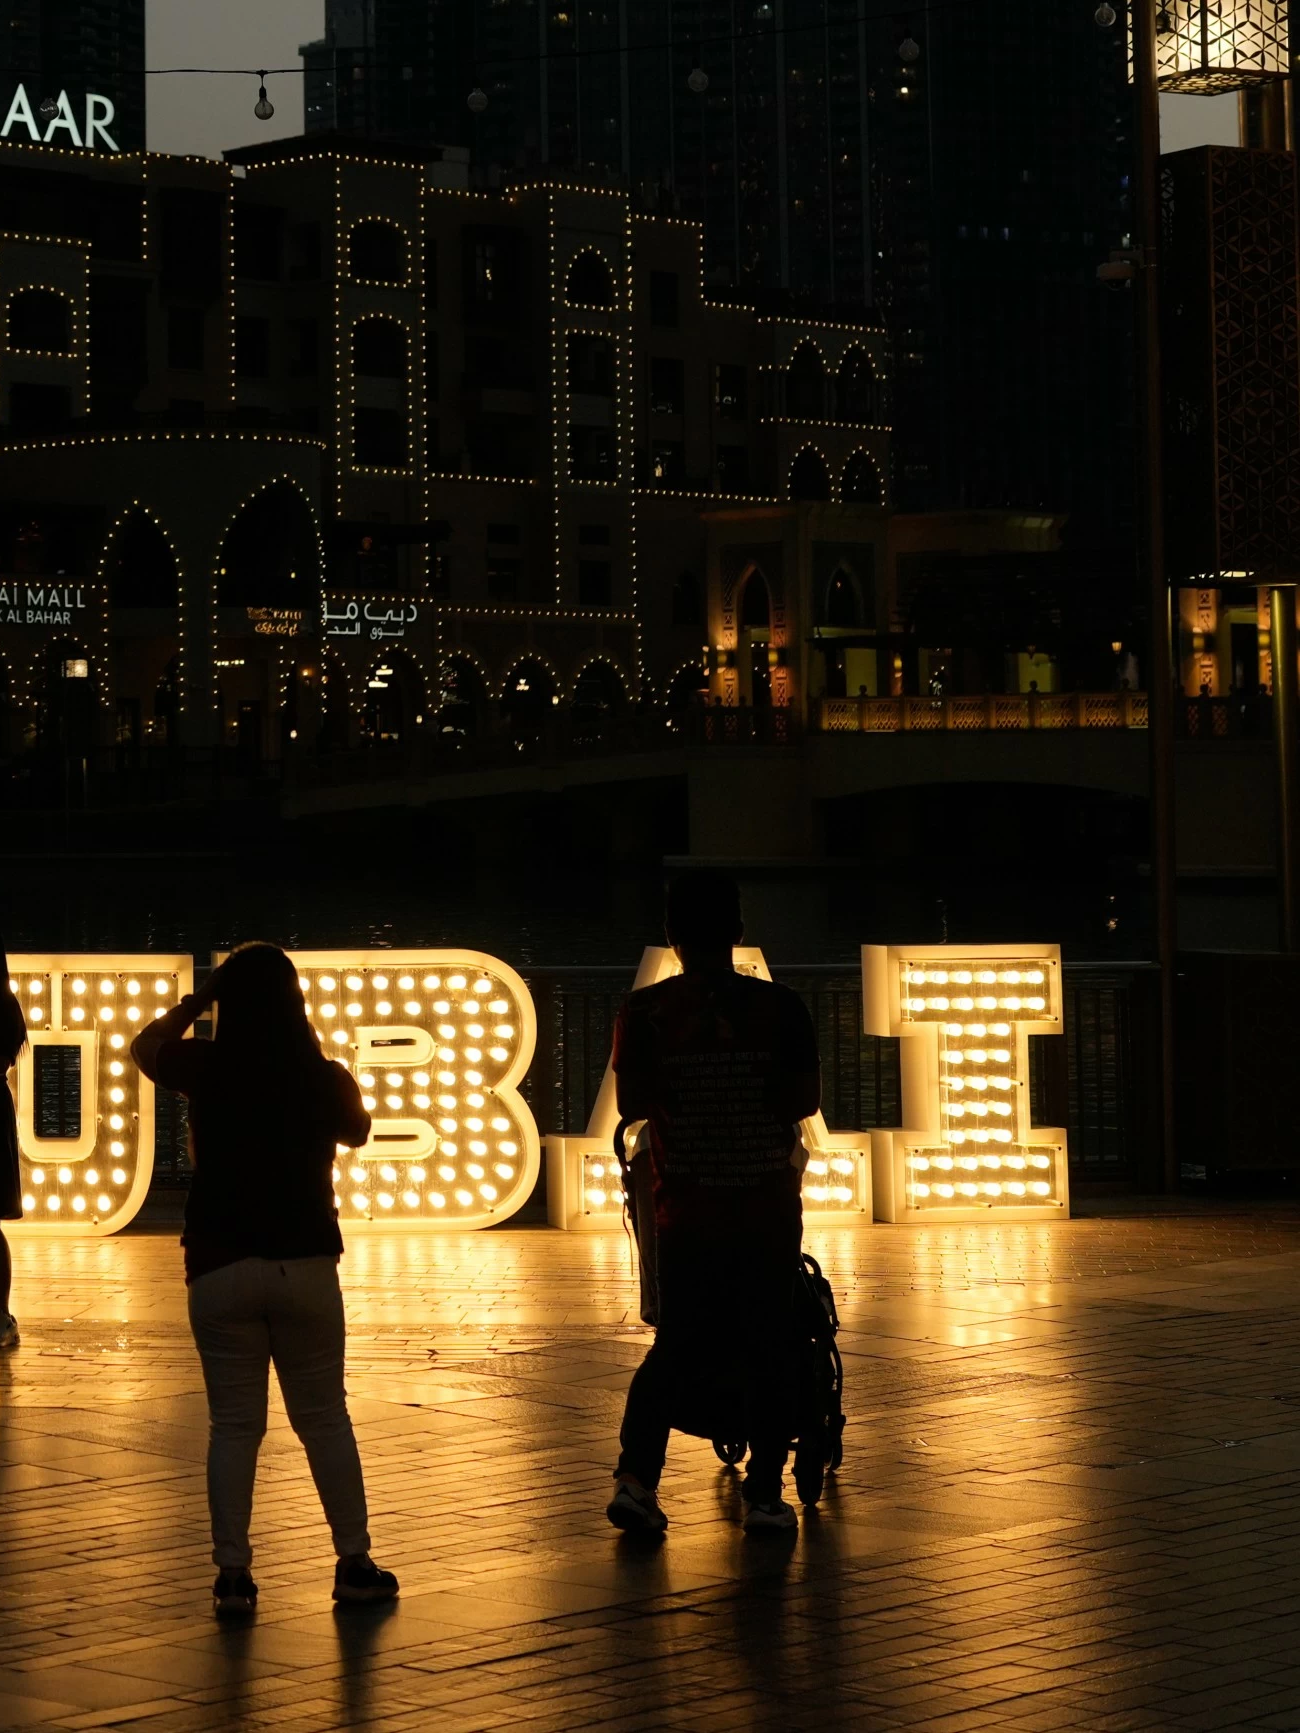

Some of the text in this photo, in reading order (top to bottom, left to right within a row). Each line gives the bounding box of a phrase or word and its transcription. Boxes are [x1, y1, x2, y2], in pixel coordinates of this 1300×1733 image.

[27, 588, 86, 608] MALL
[6, 609, 23, 623] AL
[26, 610, 71, 625] BAHAR
[363, 603, 418, 626] دبي
